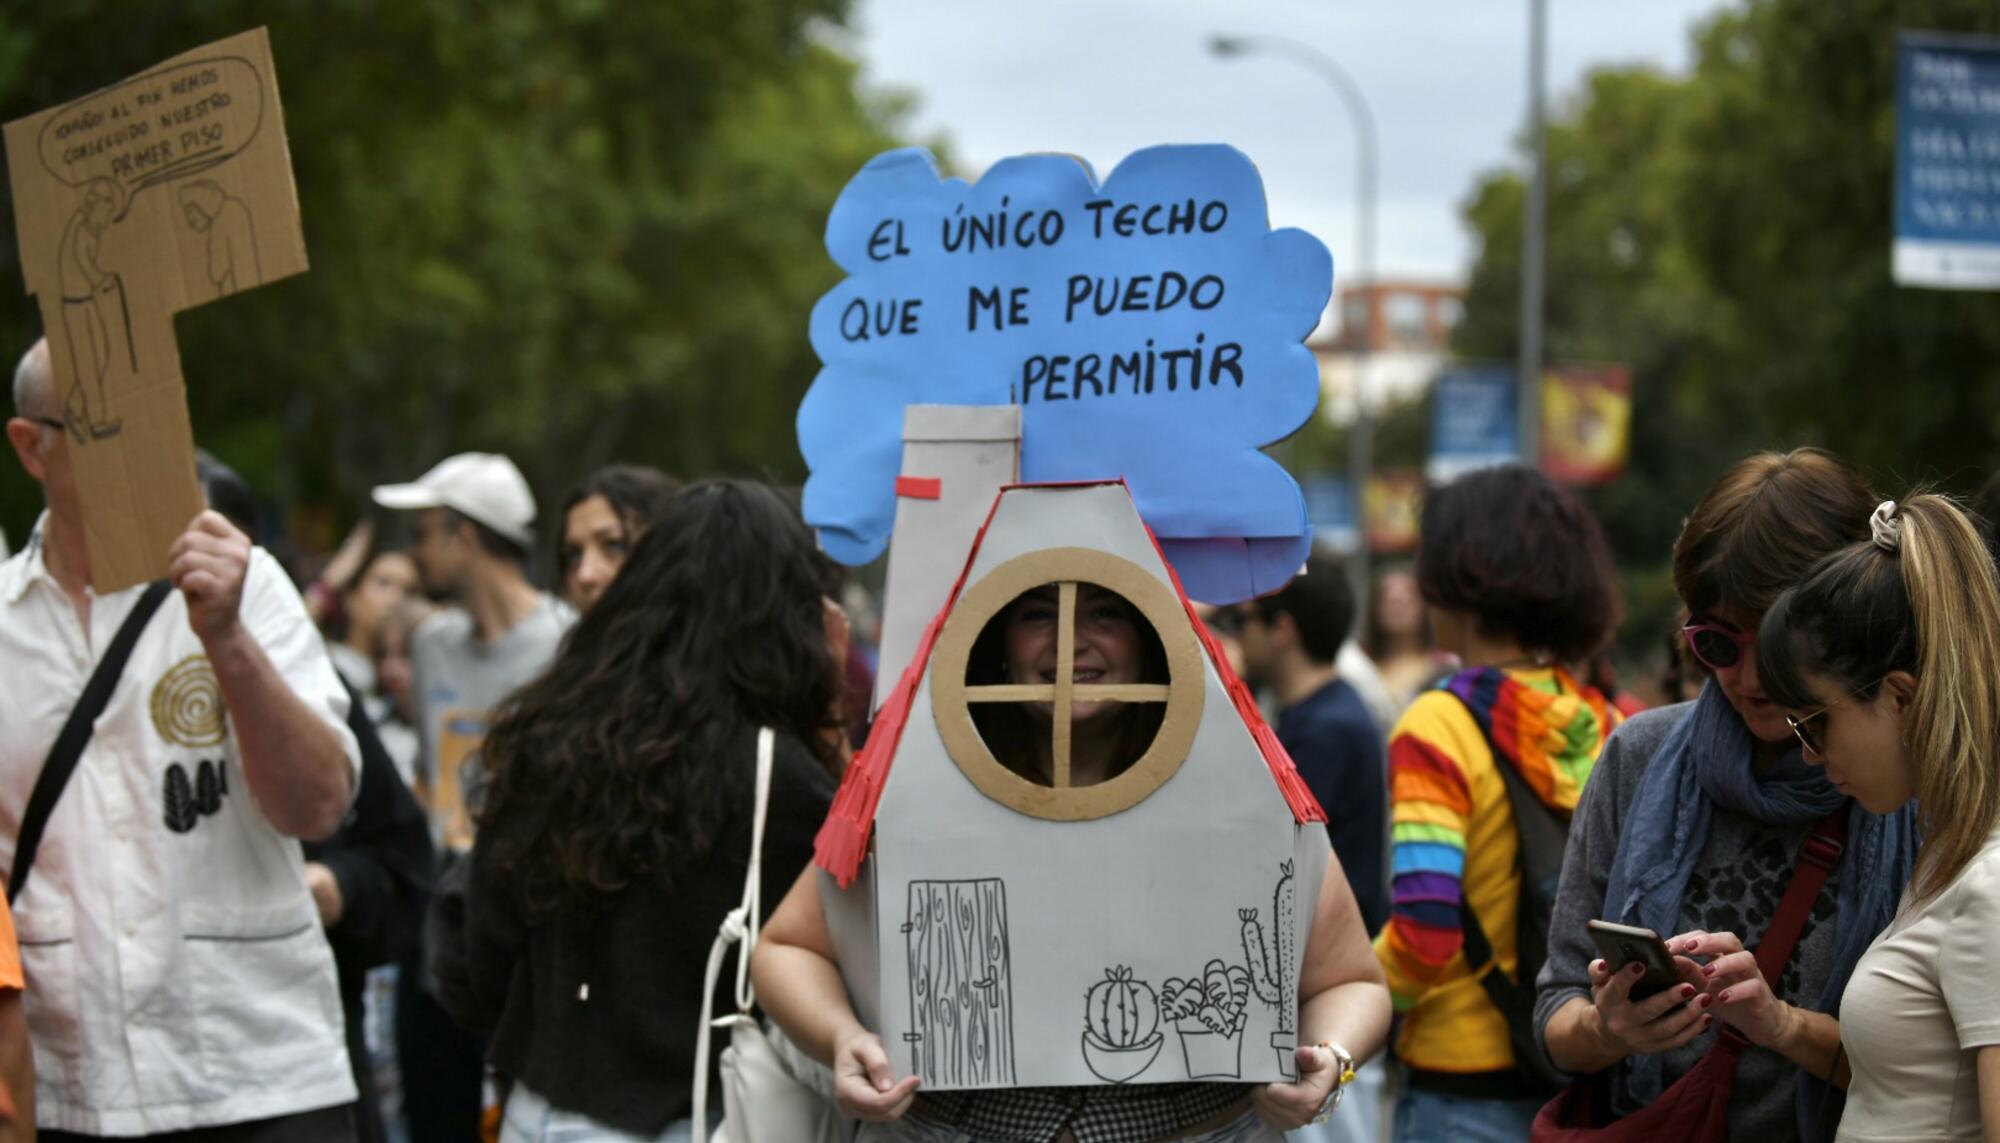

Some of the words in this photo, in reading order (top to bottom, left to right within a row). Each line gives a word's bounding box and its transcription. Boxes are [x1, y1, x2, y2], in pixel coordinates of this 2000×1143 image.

[111, 103, 130, 120] AL
[137, 88, 162, 107] FIN
[170, 68, 219, 95] HEMOS
[63, 121, 149, 165] CONSEGUIDO
[160, 92, 232, 129] NUESTRO
[112, 140, 173, 177] PRIMER
[181, 122, 223, 153] PISO
[867, 219, 911, 261] EL
[943, 196, 1064, 253] ÚNICO
[1085, 199, 1228, 239] TECHO
[840, 297, 922, 342] QUE
[968, 286, 1029, 331] ME
[1066, 271, 1225, 323] PUEDO
[1022, 333, 1244, 404] PERMITIR
